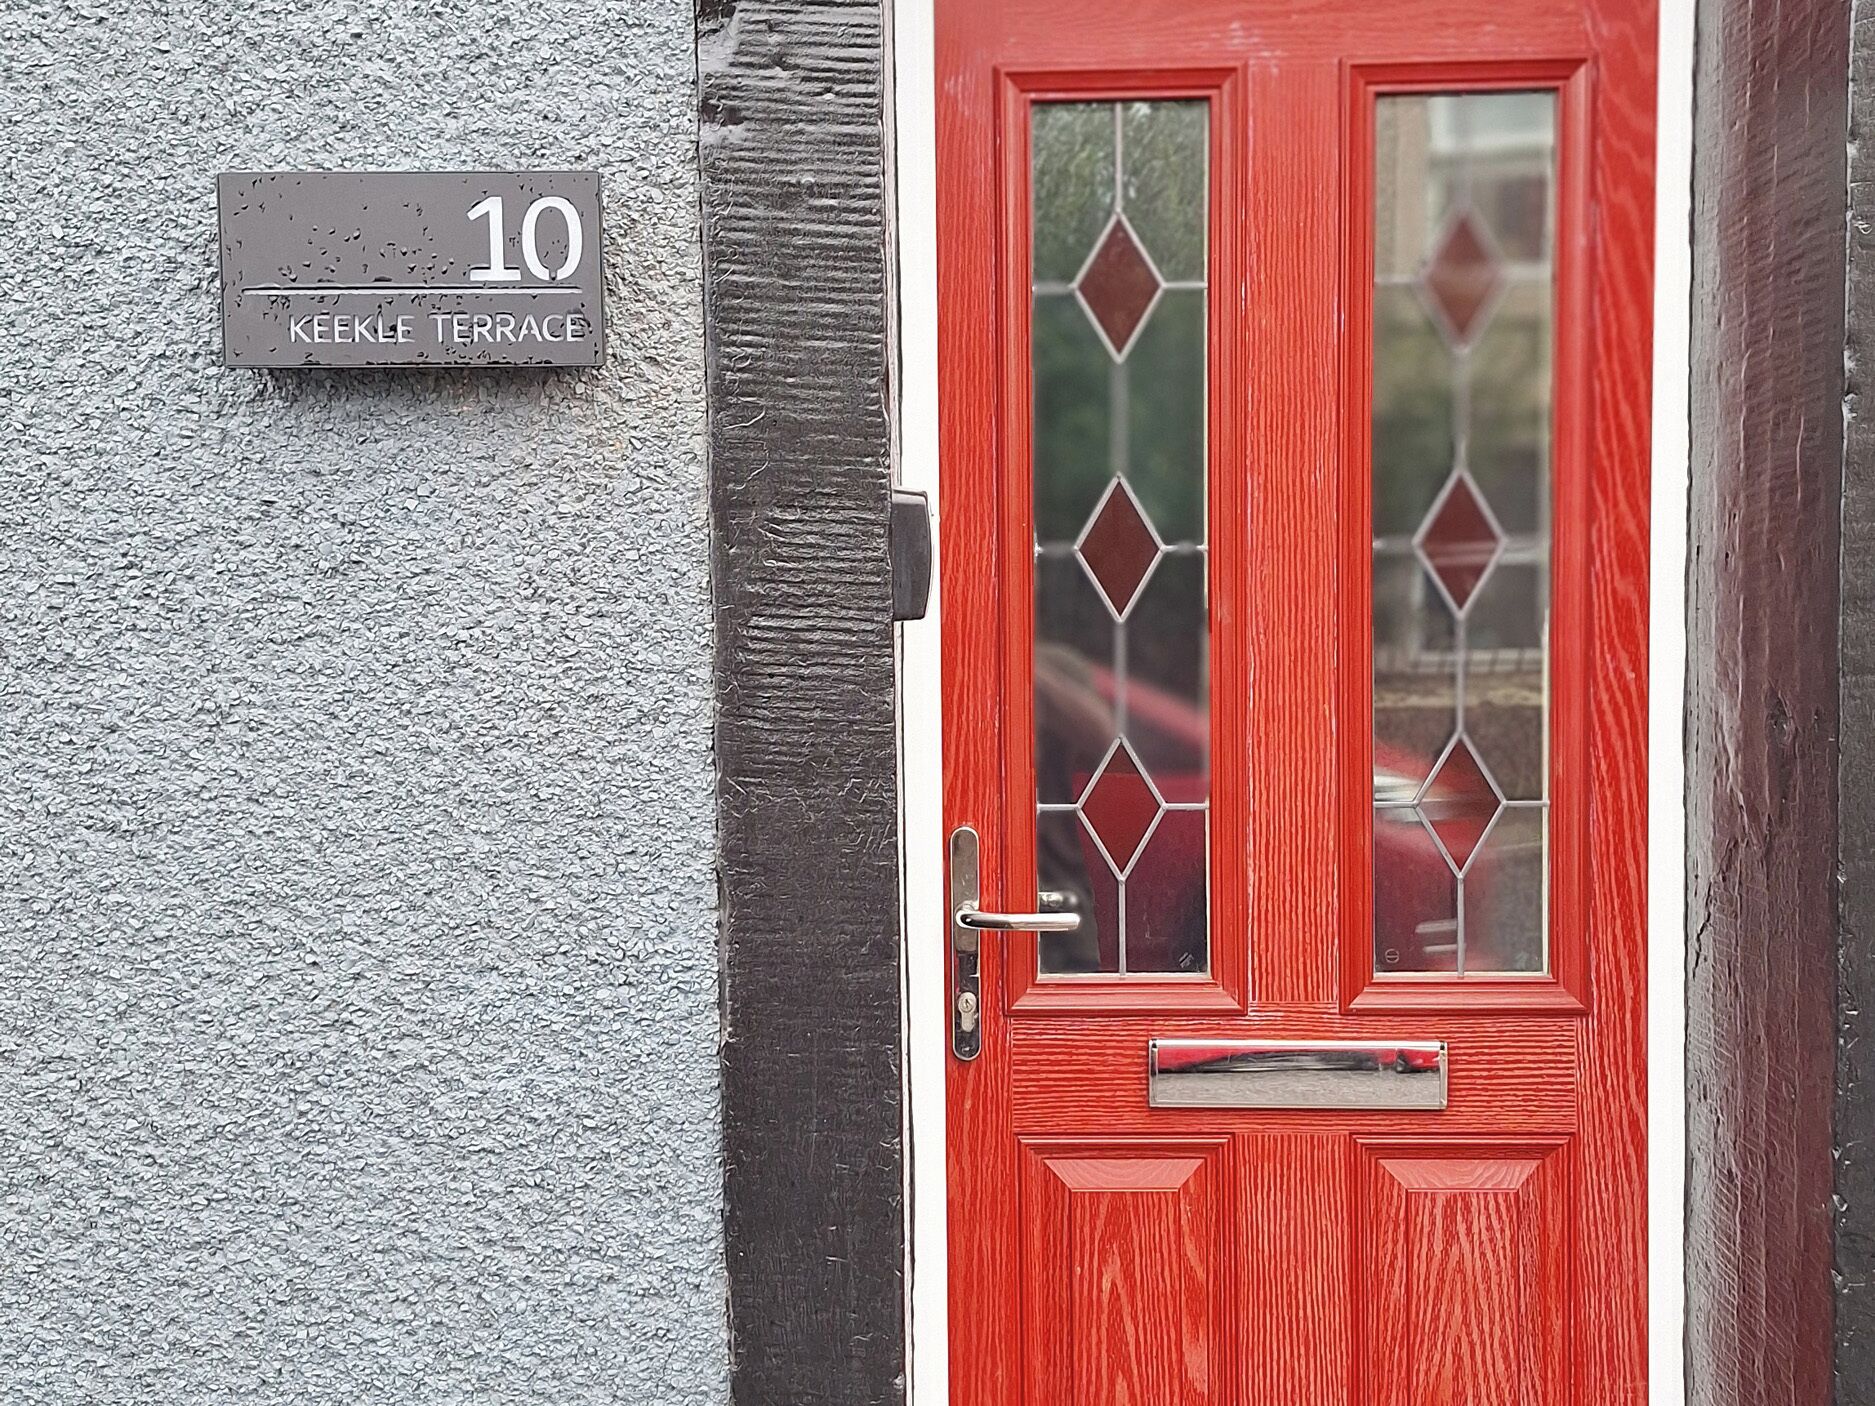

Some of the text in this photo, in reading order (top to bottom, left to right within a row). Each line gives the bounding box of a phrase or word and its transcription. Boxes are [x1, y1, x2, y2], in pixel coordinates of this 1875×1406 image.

[466, 195, 584, 282] 10
[288, 313, 584, 343] KEEKLE TERRACE
